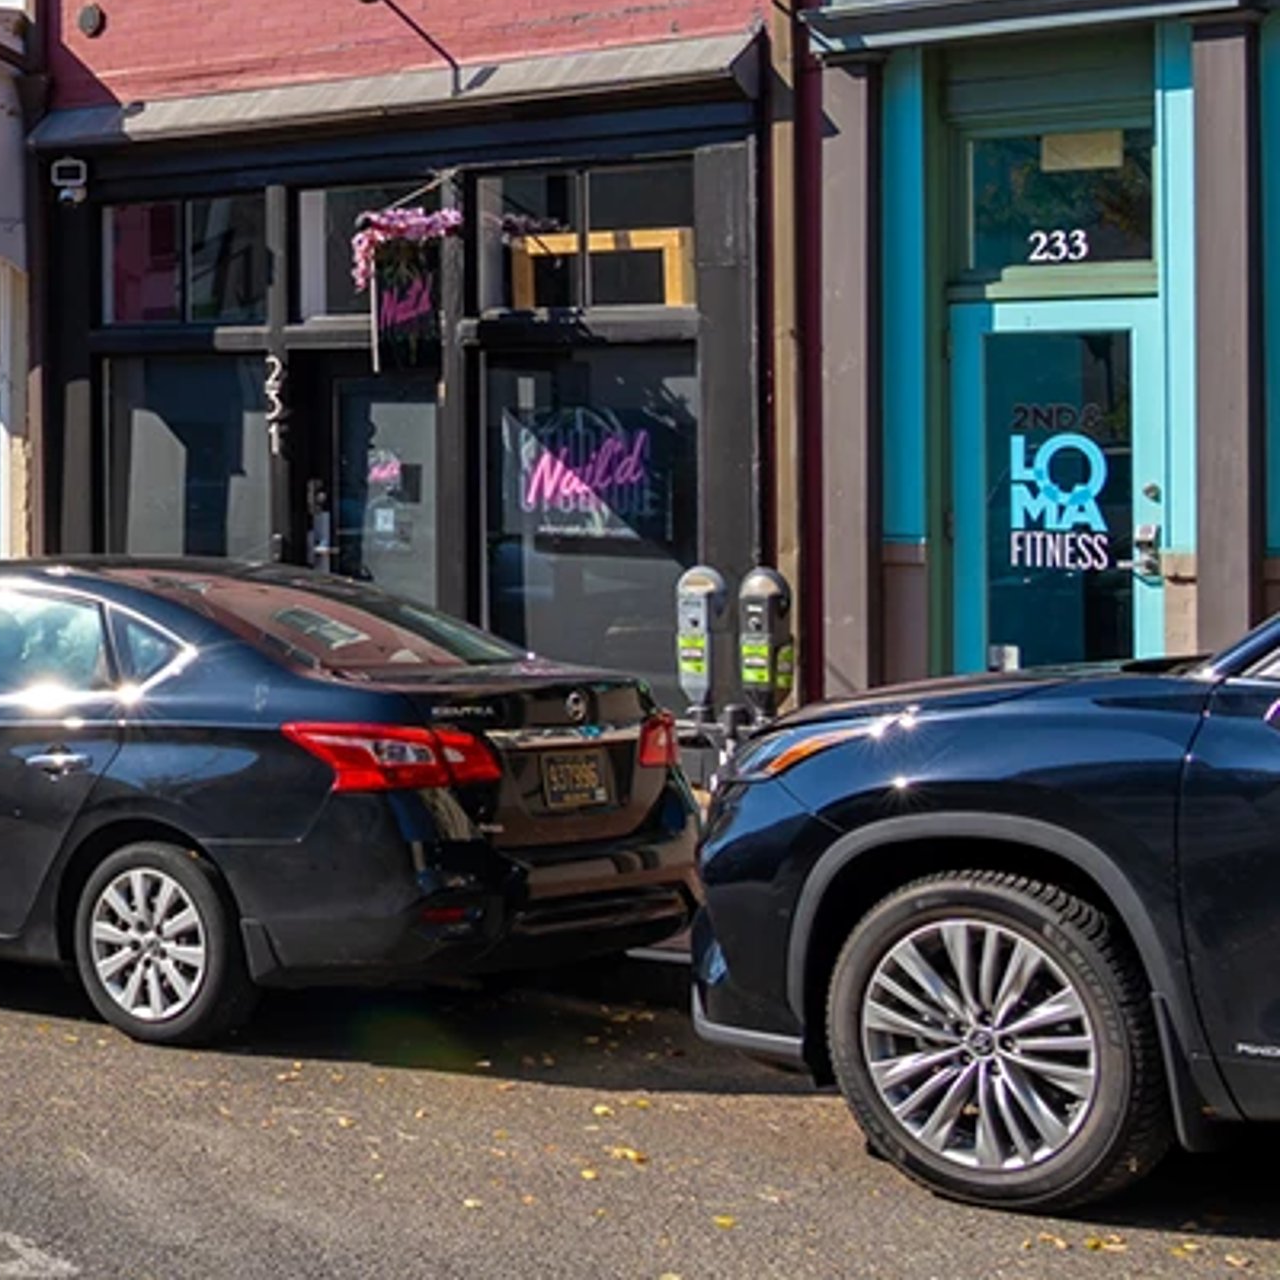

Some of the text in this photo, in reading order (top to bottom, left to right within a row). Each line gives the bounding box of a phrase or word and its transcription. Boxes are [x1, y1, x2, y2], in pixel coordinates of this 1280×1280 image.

[1028, 229, 1089, 262] 233
[265, 355, 282, 455] 231
[1013, 403, 1077, 429] 2ND
[527, 428, 648, 505] Nail'd
[1010, 530, 1109, 569] FITNESS
